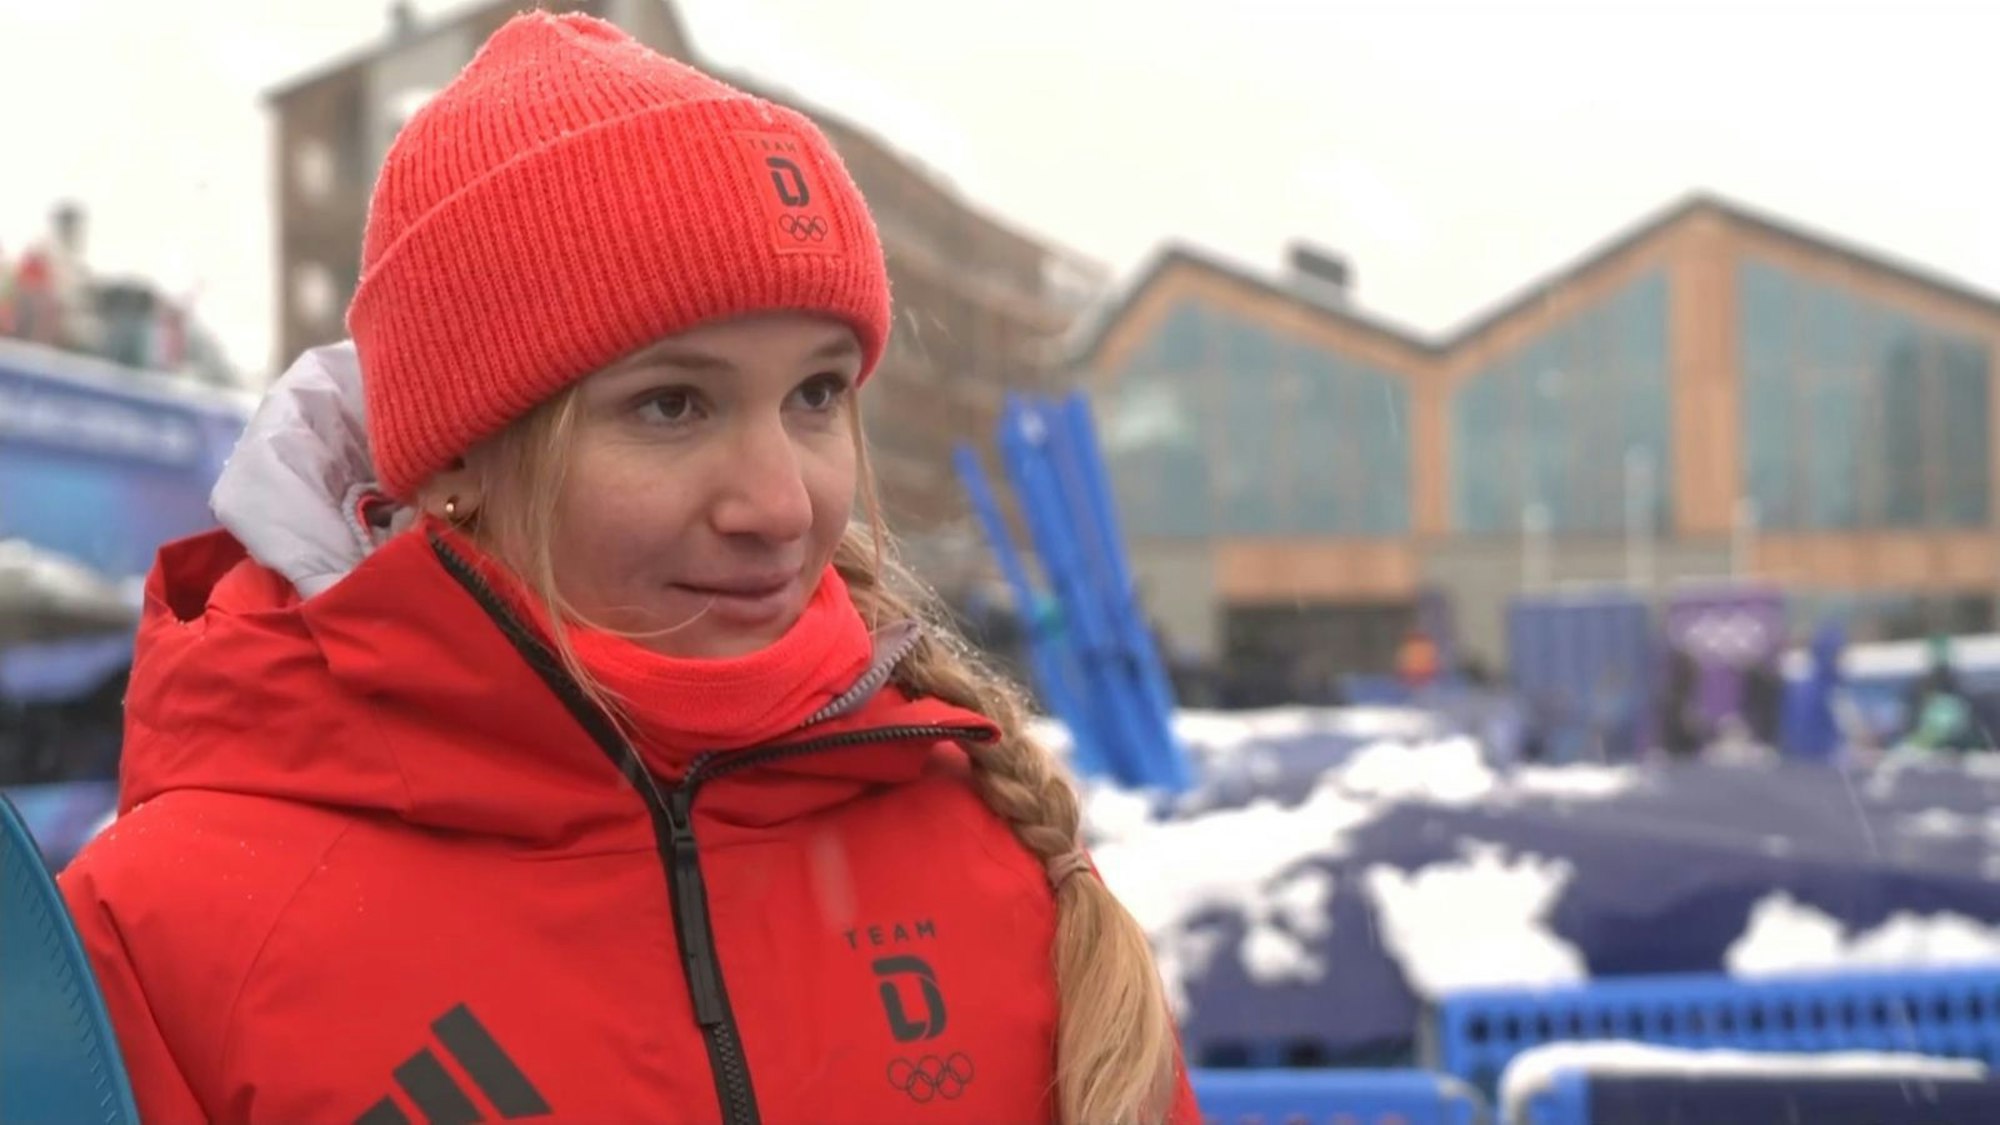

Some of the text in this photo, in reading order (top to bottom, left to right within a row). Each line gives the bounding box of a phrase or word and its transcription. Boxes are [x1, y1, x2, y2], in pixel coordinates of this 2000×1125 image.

[766, 156, 810, 207] D
[843, 919, 936, 949] TEAM
[872, 954, 947, 1042] D
